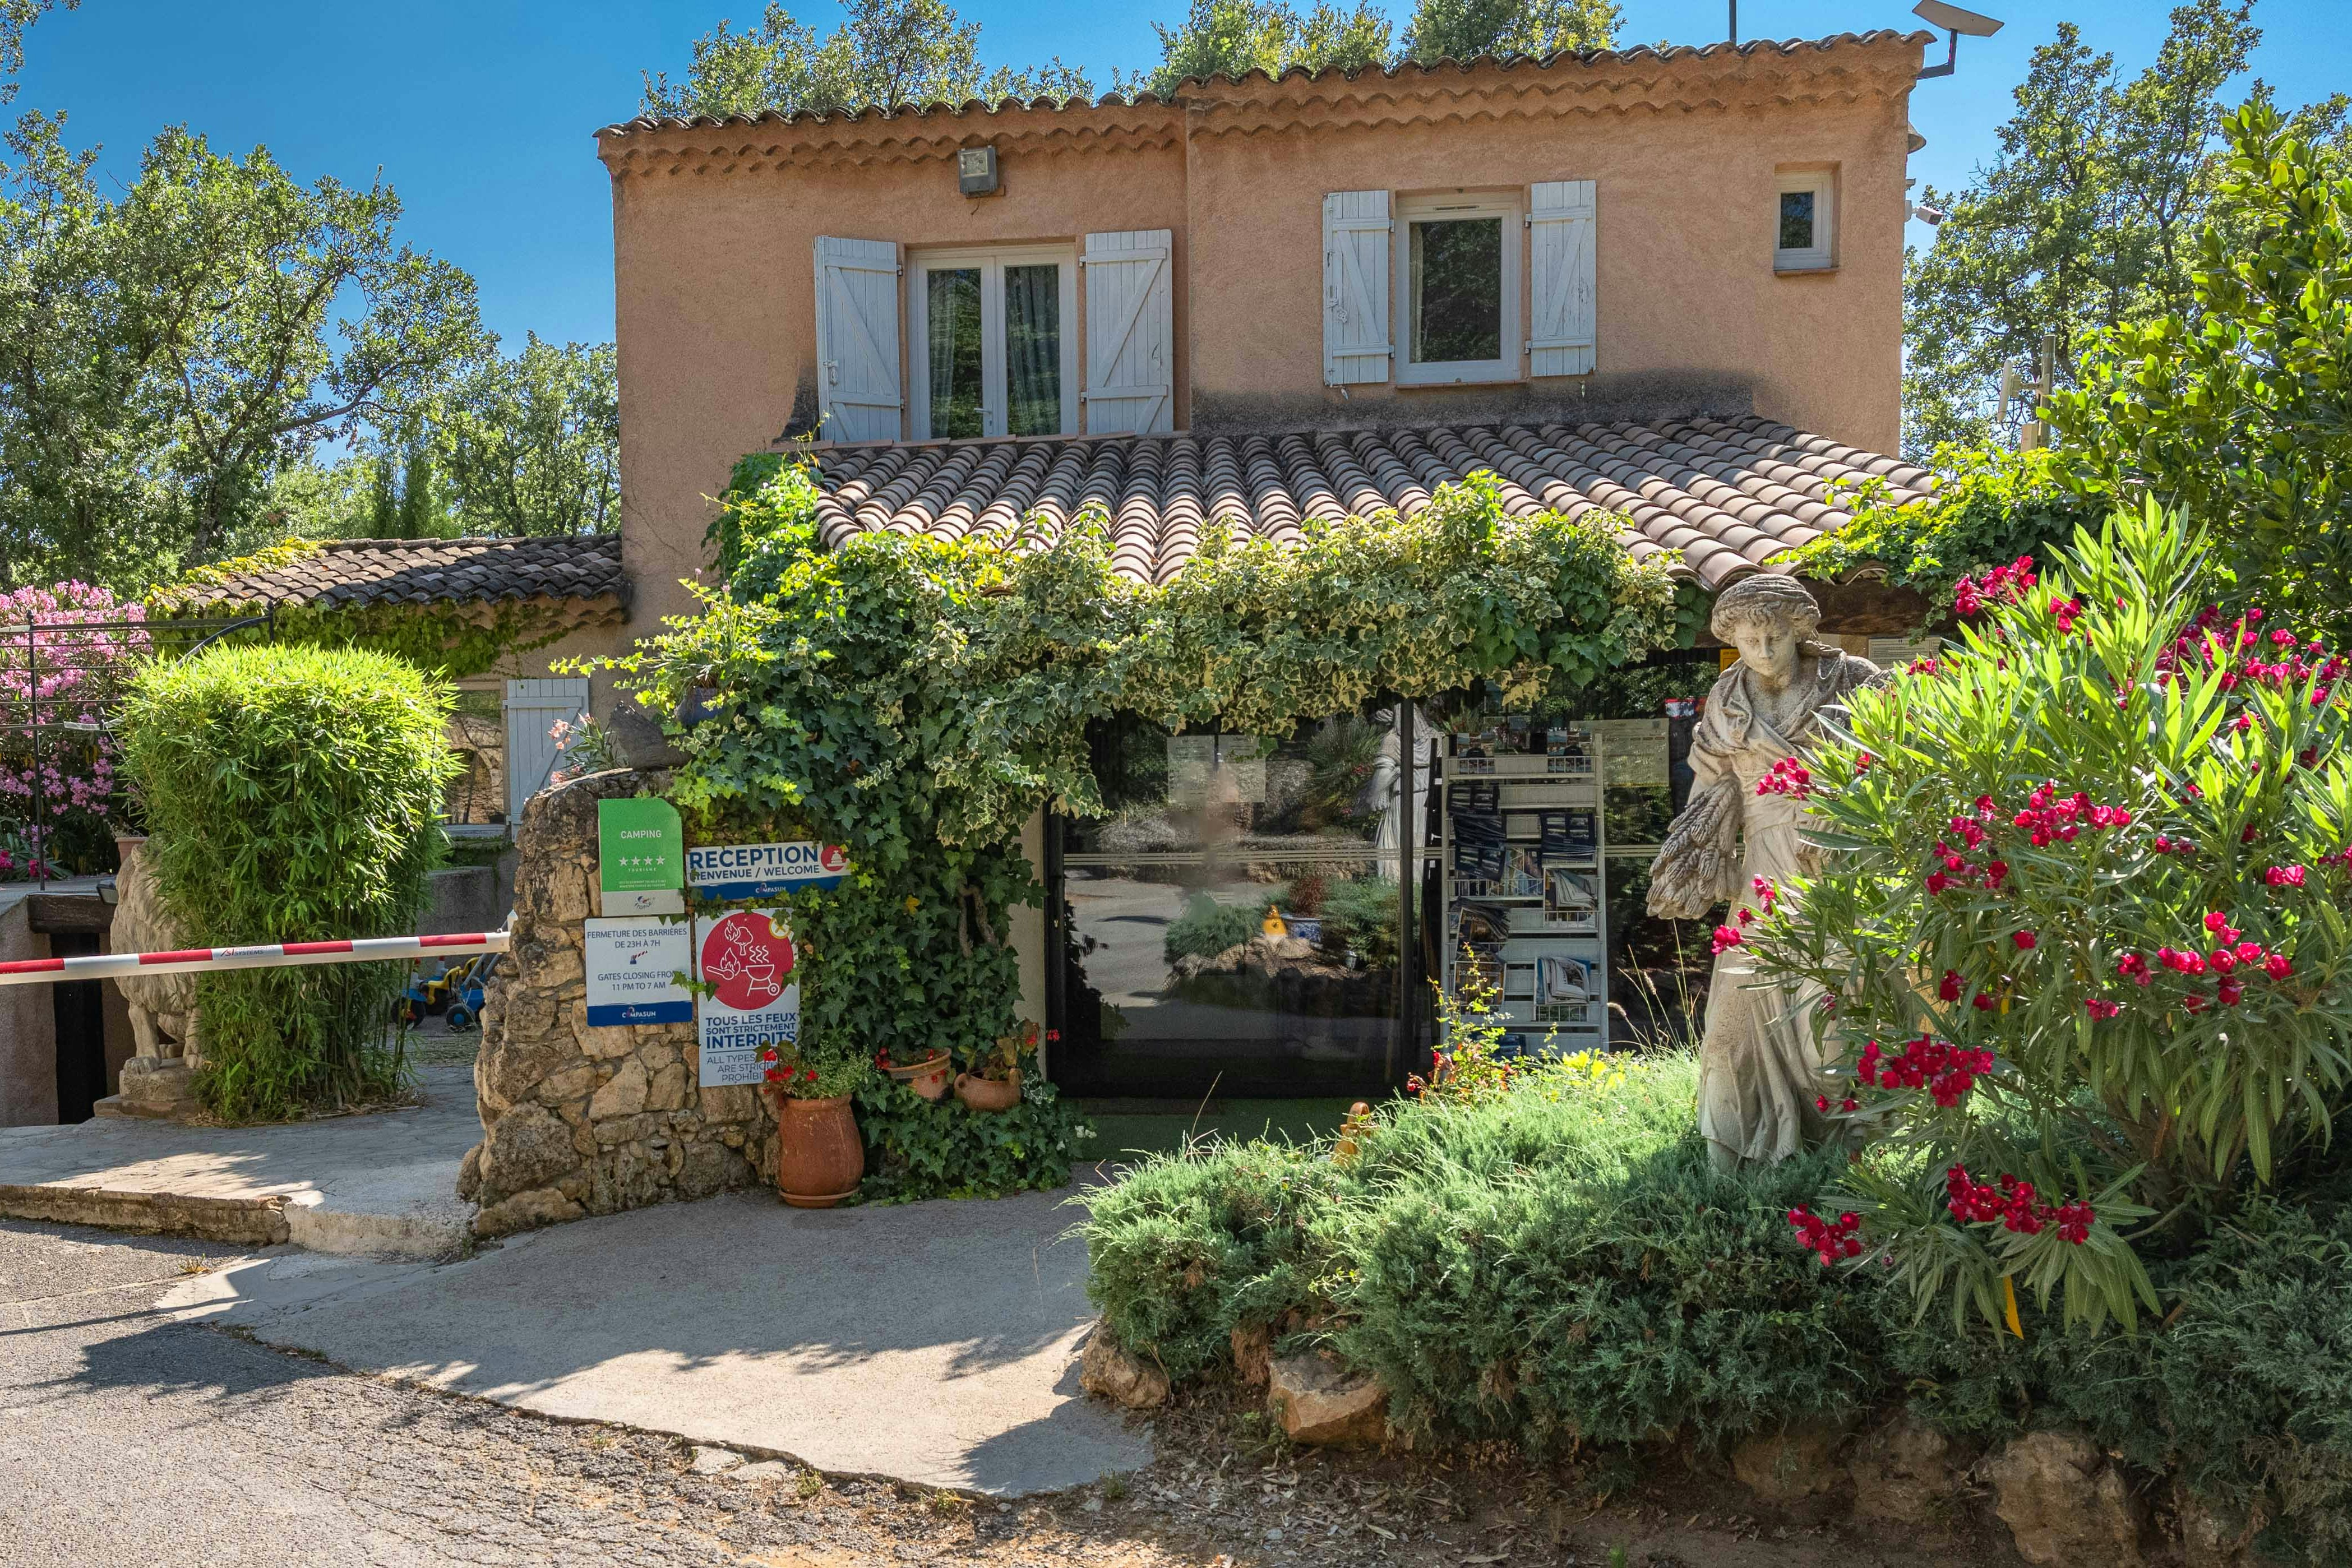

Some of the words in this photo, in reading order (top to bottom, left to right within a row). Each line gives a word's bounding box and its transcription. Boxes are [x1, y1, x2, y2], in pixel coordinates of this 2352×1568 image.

[621, 830, 662, 839] CAMPING
[689, 845, 819, 869] RECEPTION
[690, 869, 752, 881] IENVENUE
[764, 864, 820, 876] WELCOME
[587, 929, 631, 938] FERMETURE
[632, 929, 648, 937] DES
[649, 927, 687, 936] BARRIÈRES
[598, 973, 621, 981] GATES
[623, 972, 655, 980] CLOSING
[705, 1016, 738, 1026] TOUS
[741, 1014, 762, 1024] LES
[766, 1012, 796, 1023] FEUX
[706, 1026, 731, 1035] SONT
[733, 1023, 796, 1033] STRICTEMENT
[706, 1055, 724, 1064] ALL
[726, 1053, 755, 1062] TYPES
[717, 1064, 736, 1072] ARE
[722, 1072, 764, 1082] PROHIBI
